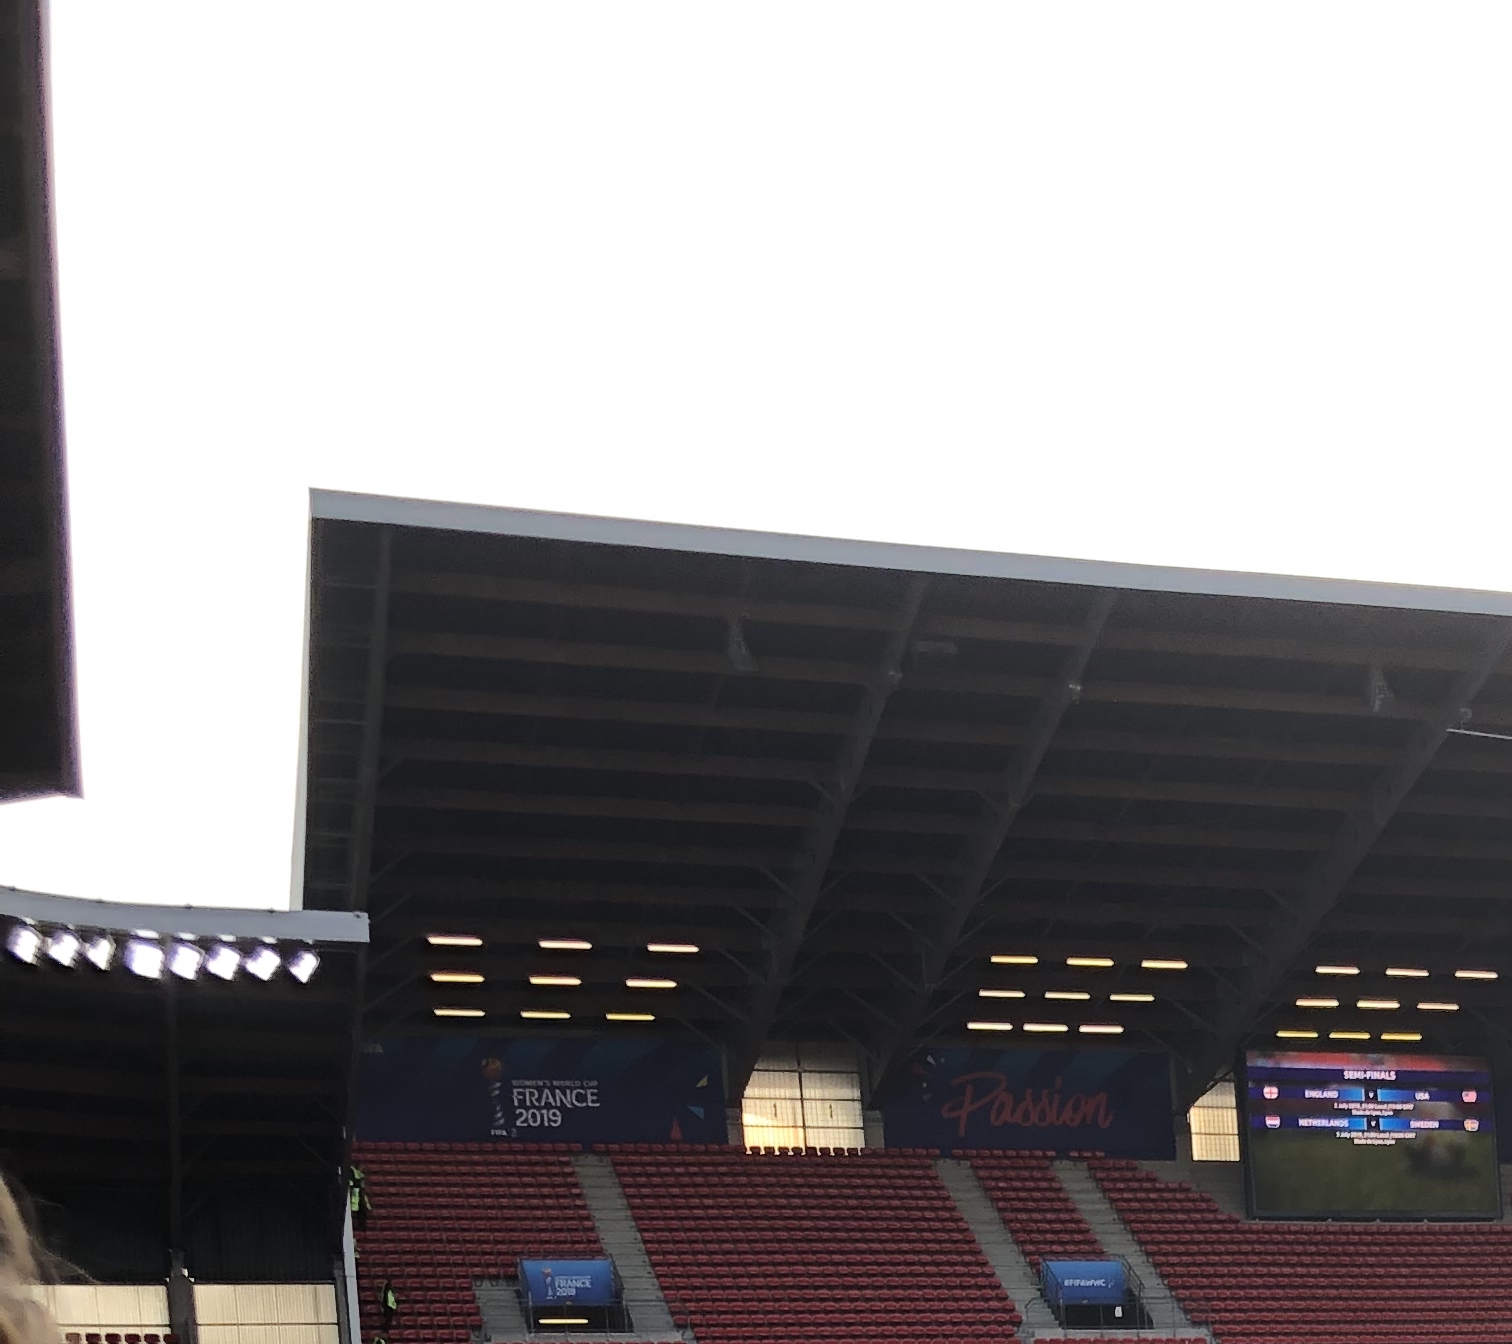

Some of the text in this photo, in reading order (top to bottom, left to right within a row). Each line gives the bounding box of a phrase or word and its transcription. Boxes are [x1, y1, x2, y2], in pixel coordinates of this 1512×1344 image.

[1343, 1070, 1396, 1081] SEMI-FINALS
[511, 1088, 601, 1108] FRANCE
[1304, 1089, 1339, 1099] ENGLAND
[1414, 1091, 1431, 1101] USA
[941, 1071, 1114, 1138] Passion
[515, 1108, 563, 1127] 2019
[1409, 1120, 1440, 1130] SWEDEN
[555, 1278, 592, 1289] FRANCE
